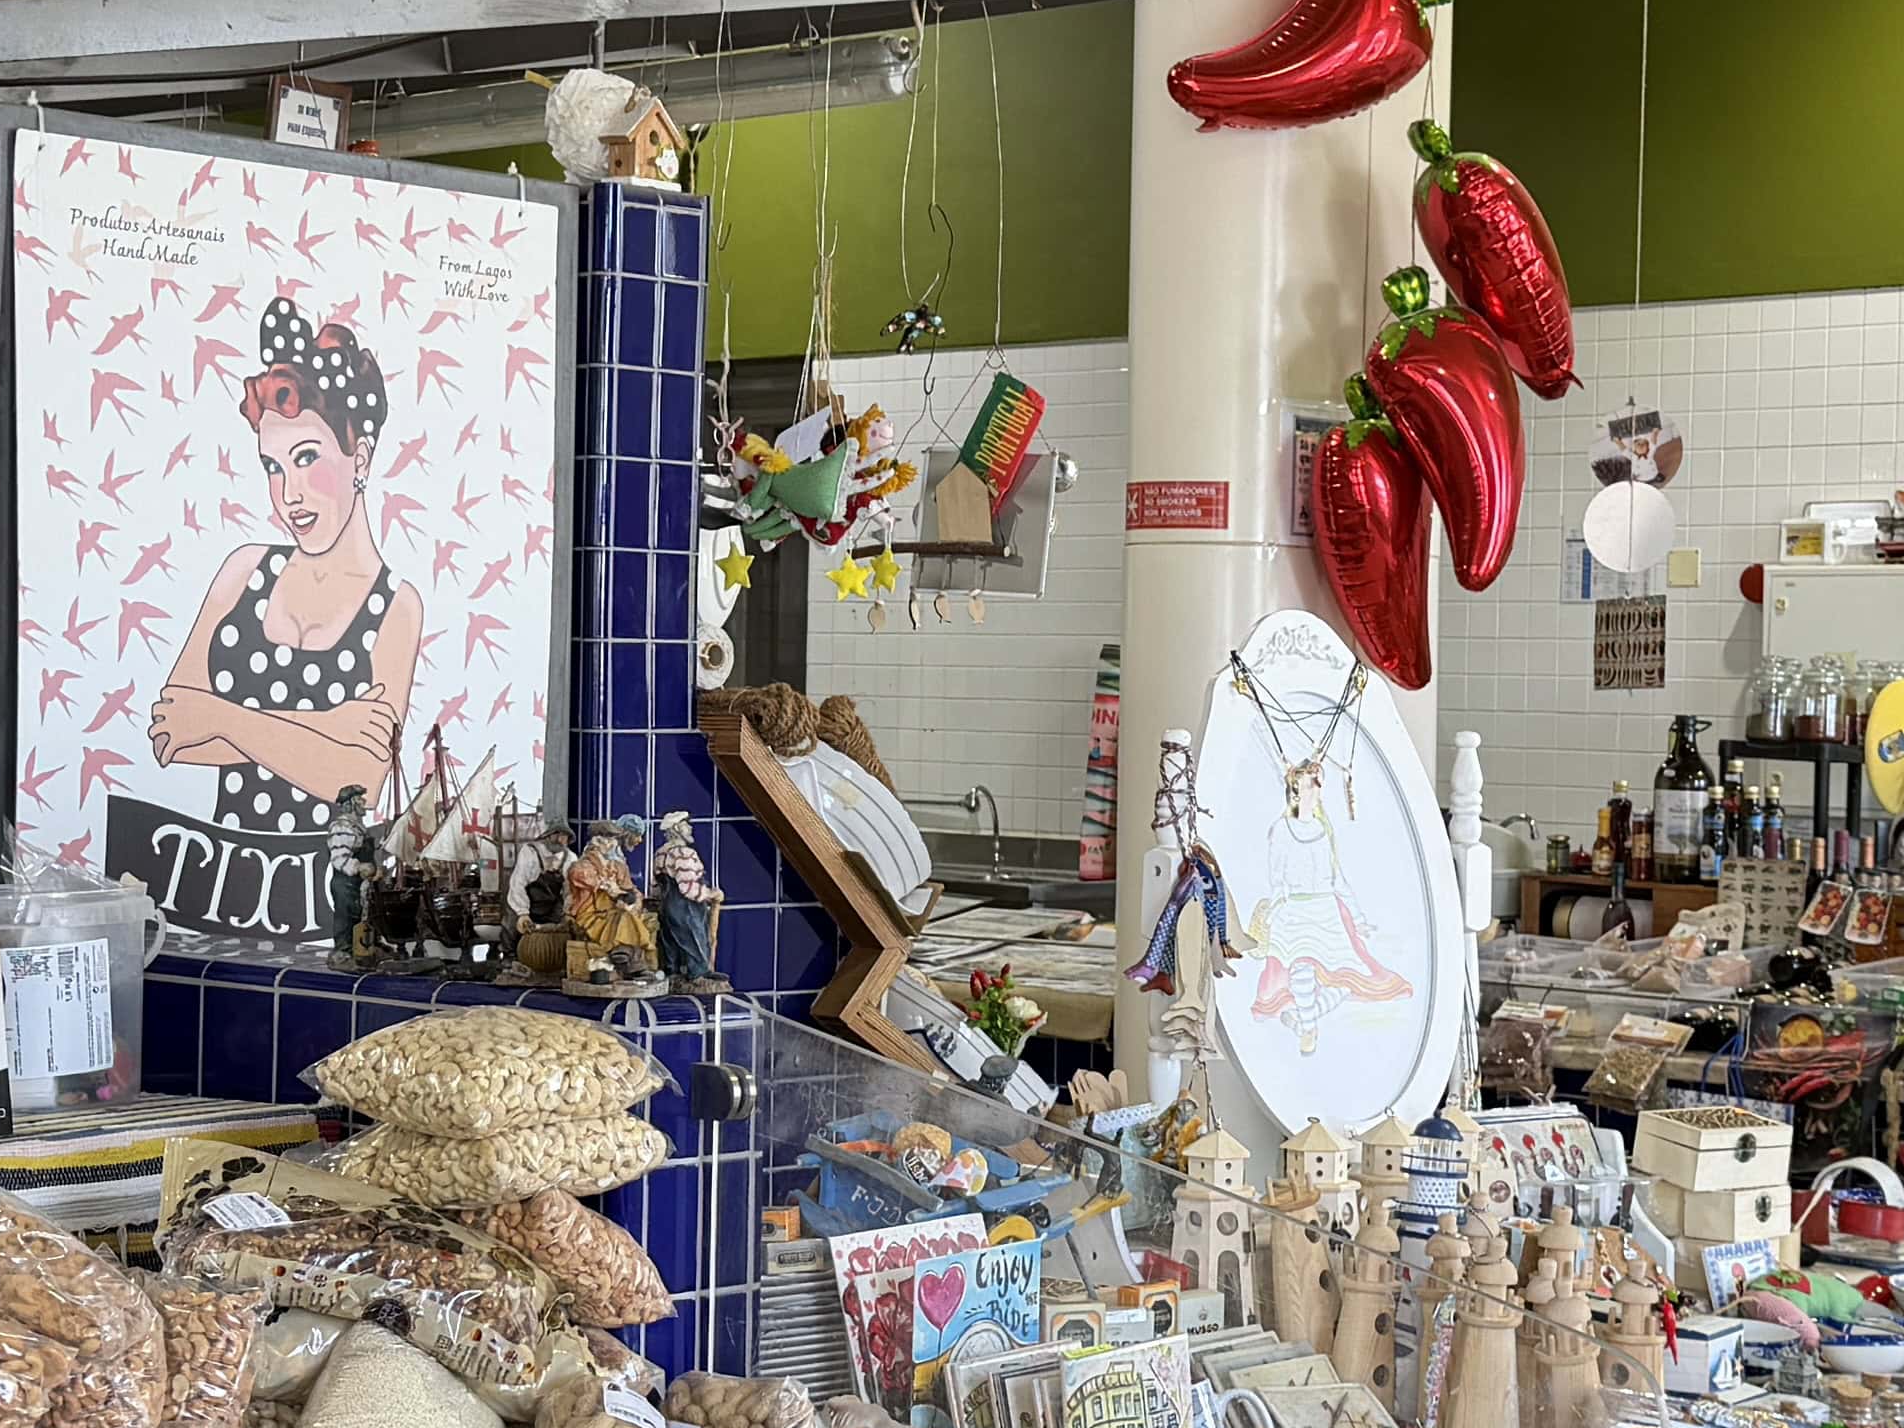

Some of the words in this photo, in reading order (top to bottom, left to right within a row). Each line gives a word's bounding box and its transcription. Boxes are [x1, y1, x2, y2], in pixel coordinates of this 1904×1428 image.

[69, 206, 141, 235] Produtos
[146, 217, 226, 244] Artesanais
[102, 238, 147, 261] Hand
[148, 242, 200, 266] Made
[438, 255, 473, 276] From
[476, 259, 513, 288] Lagos
[444, 279, 477, 301] With
[478, 282, 511, 303] Love
[975, 386, 1036, 476] PORTUGAL
[1156, 497, 1197, 506] SMOKERS
[1162, 486, 1217, 496] FUMADORES
[1161, 508, 1201, 517] FUMEURS
[975, 1250, 1034, 1298] Enjoy
